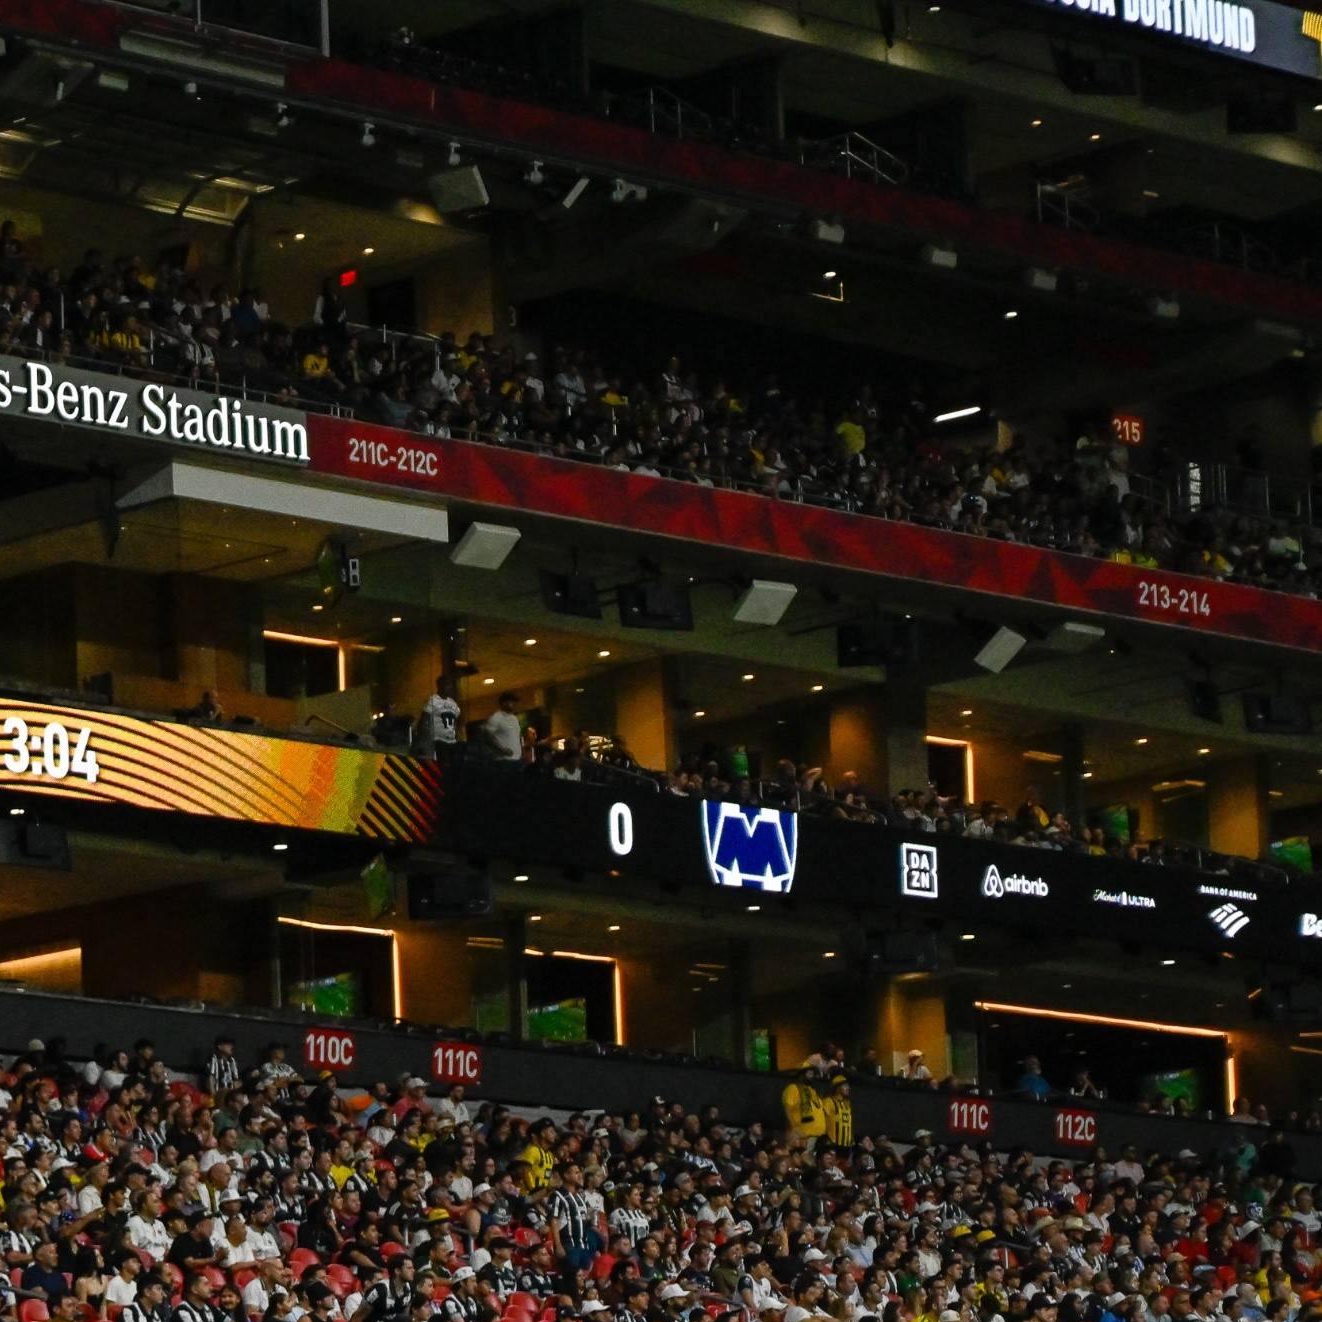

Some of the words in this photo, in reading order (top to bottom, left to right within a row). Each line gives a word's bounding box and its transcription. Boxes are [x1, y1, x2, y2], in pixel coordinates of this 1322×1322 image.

[142, 384, 311, 462] Stadium
[348, 437, 439, 478] 211C-212C
[1139, 581, 1211, 617] 213-214
[3, 716, 100, 783] 3:04
[609, 801, 633, 856] 0
[1004, 873, 1049, 897] airbnb
[1128, 894, 1156, 909] ULTRA
[306, 1034, 353, 1068] 110C
[434, 1043, 478, 1078] 111C
[951, 1102, 989, 1130] 111C
[1057, 1114, 1095, 1142] 112C
